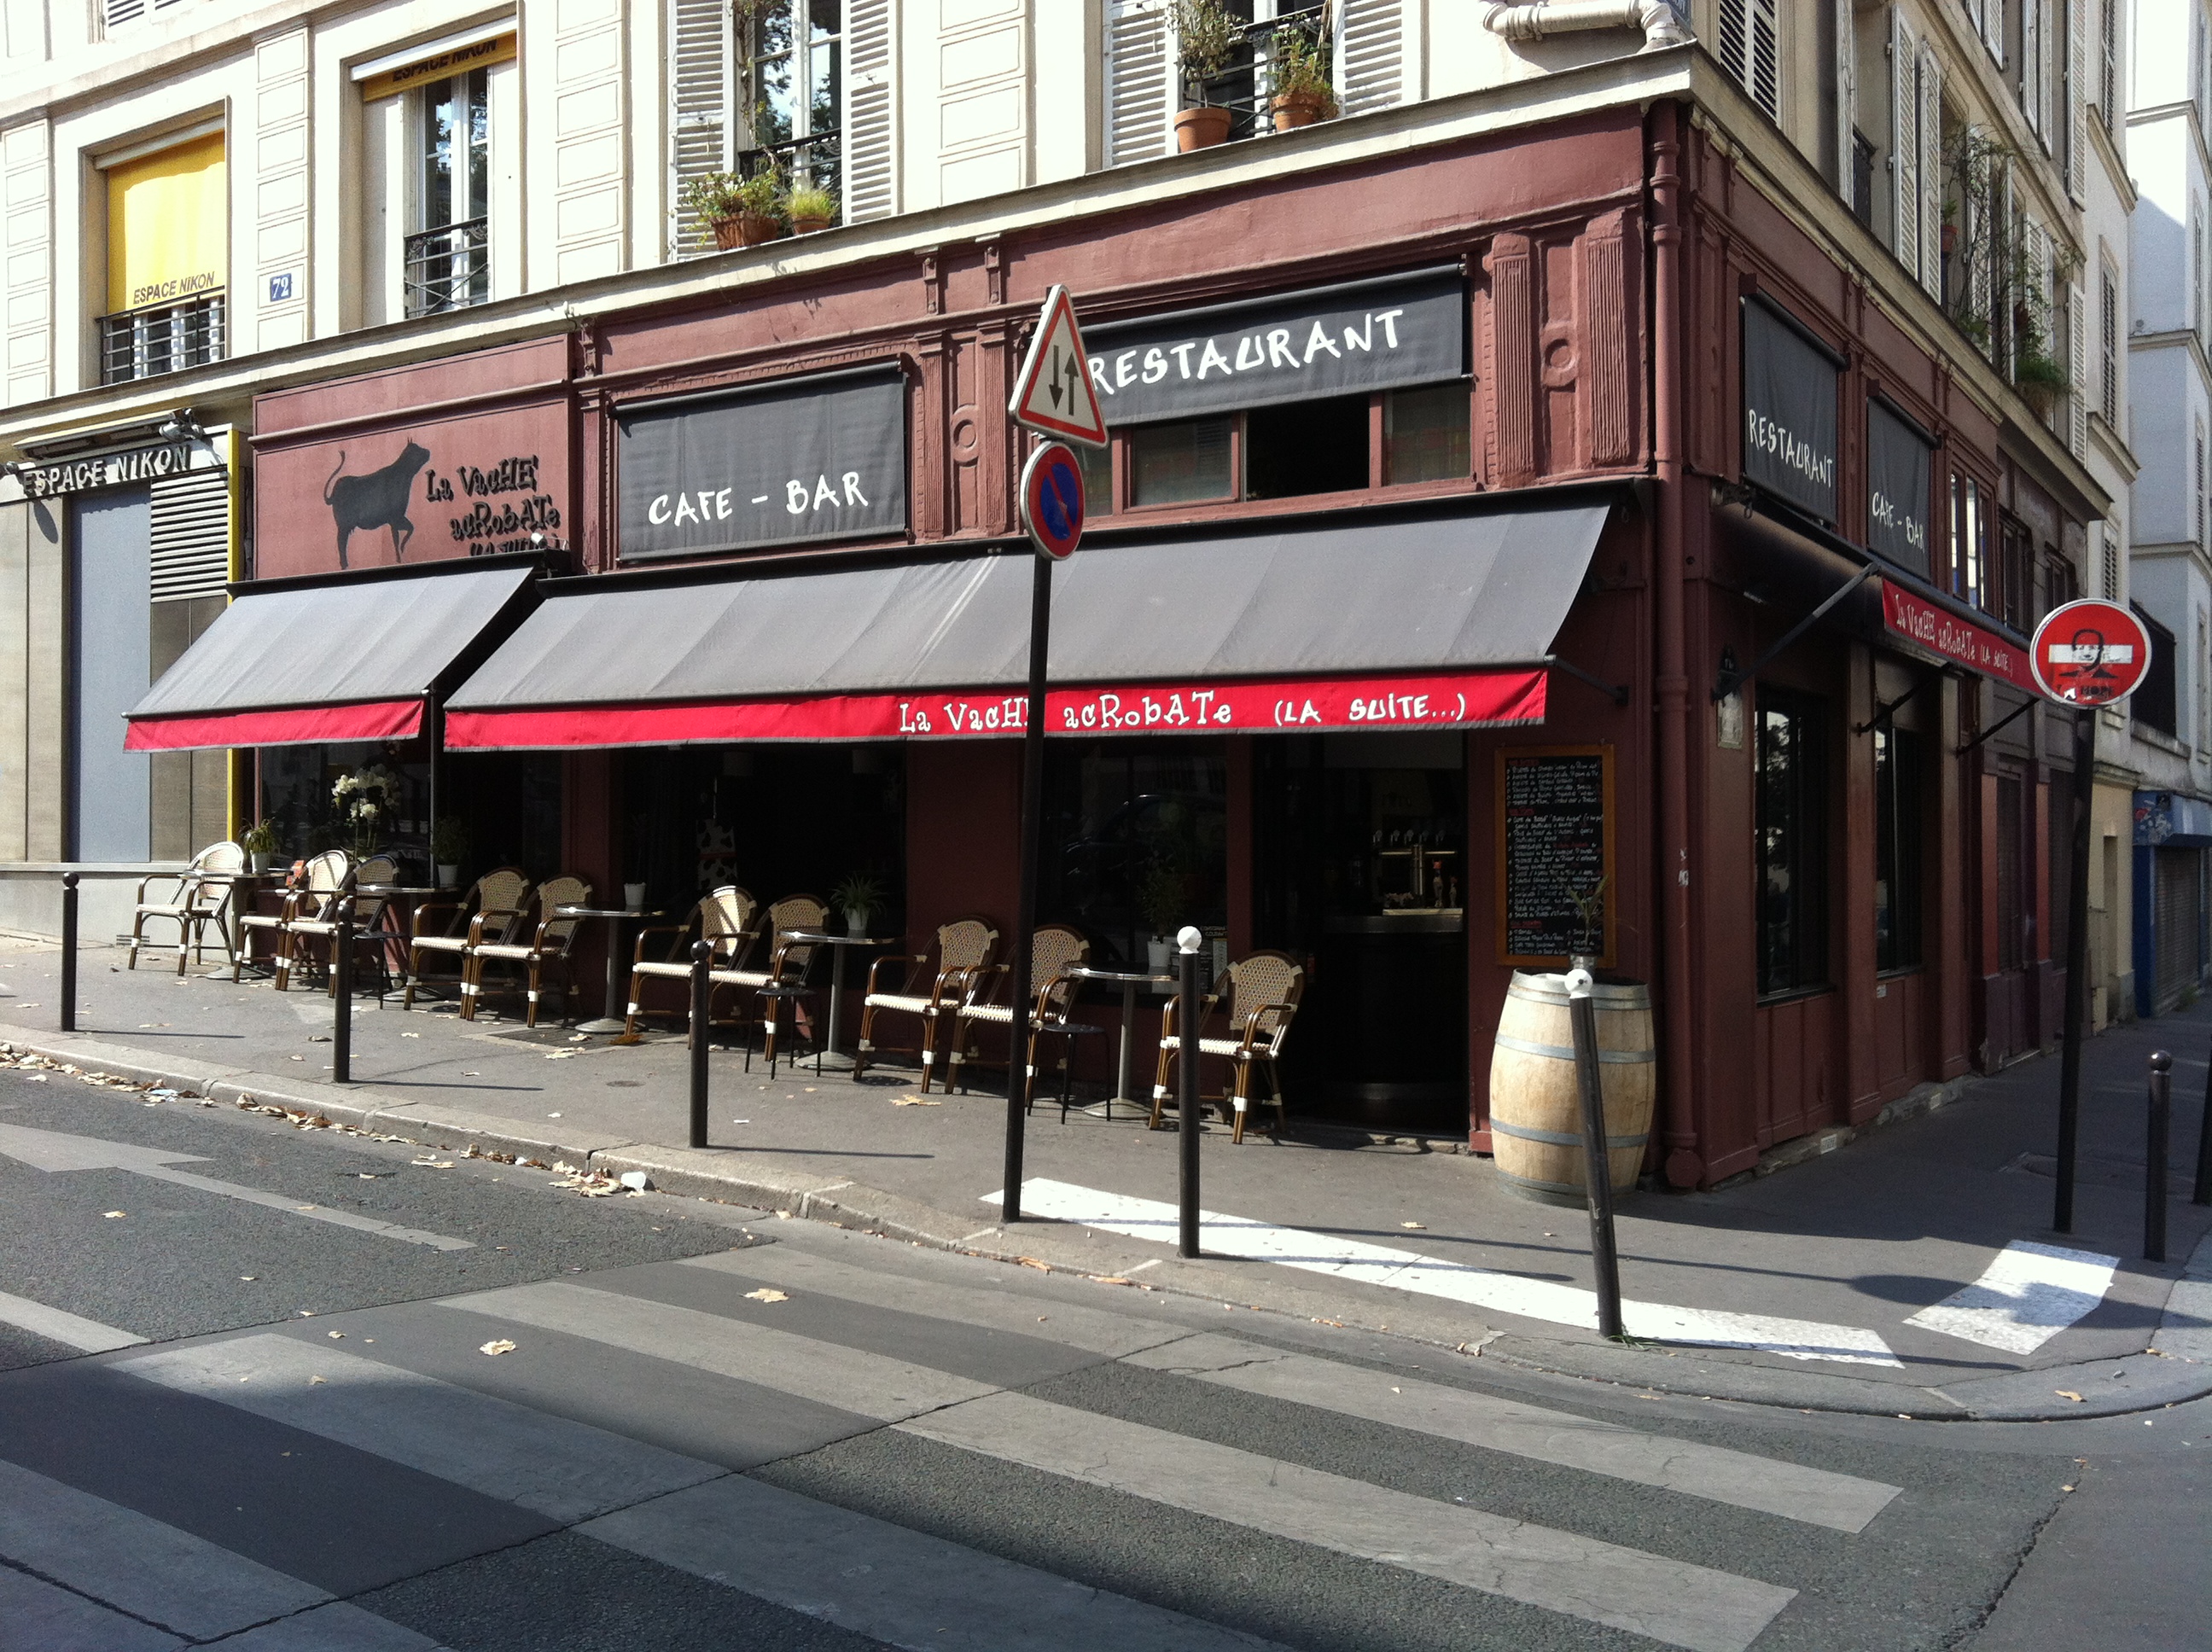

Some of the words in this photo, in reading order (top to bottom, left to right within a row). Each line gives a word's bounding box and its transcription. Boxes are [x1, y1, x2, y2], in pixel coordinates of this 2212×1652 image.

[132, 280, 177, 305] ESPACE
[271, 276, 290, 299] 72
[1087, 309, 1404, 395] RESTAURANT
[1749, 409, 1833, 488] RESTAURANT
[22, 460, 105, 492] ESPACE
[115, 445, 190, 482] NIKON
[425, 469, 454, 502] La
[648, 487, 733, 526] CAFE
[786, 471, 869, 515] BAR
[1906, 515, 1925, 554] BAR
[899, 702, 932, 733] La
[944, 696, 1029, 731] VacH
[1274, 699, 1322, 726] (LA
